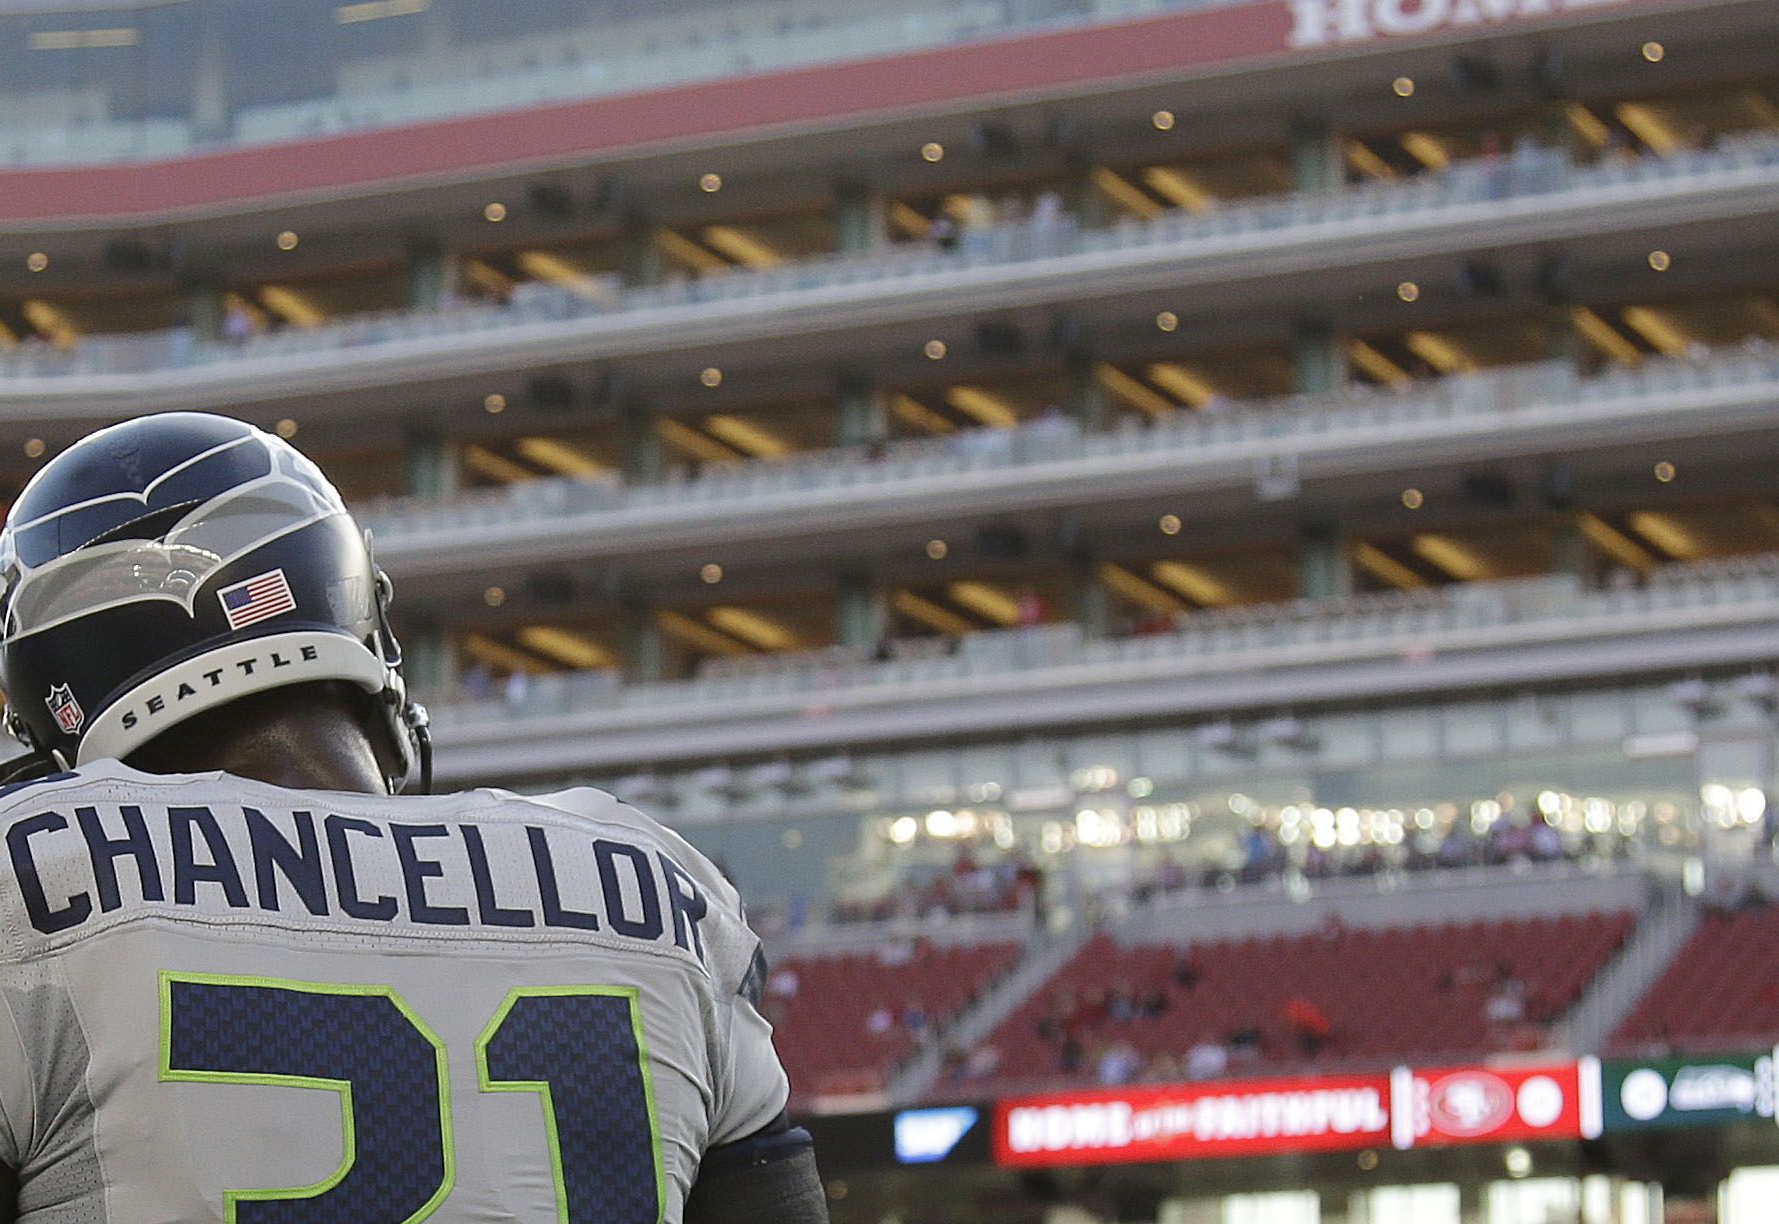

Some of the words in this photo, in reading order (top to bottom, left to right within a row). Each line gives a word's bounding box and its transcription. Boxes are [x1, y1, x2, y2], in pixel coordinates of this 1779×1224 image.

[55, 700, 82, 730] NFL
[121, 644, 320, 731] SEATTLE
[5, 805, 708, 967] CHANCELLOR
